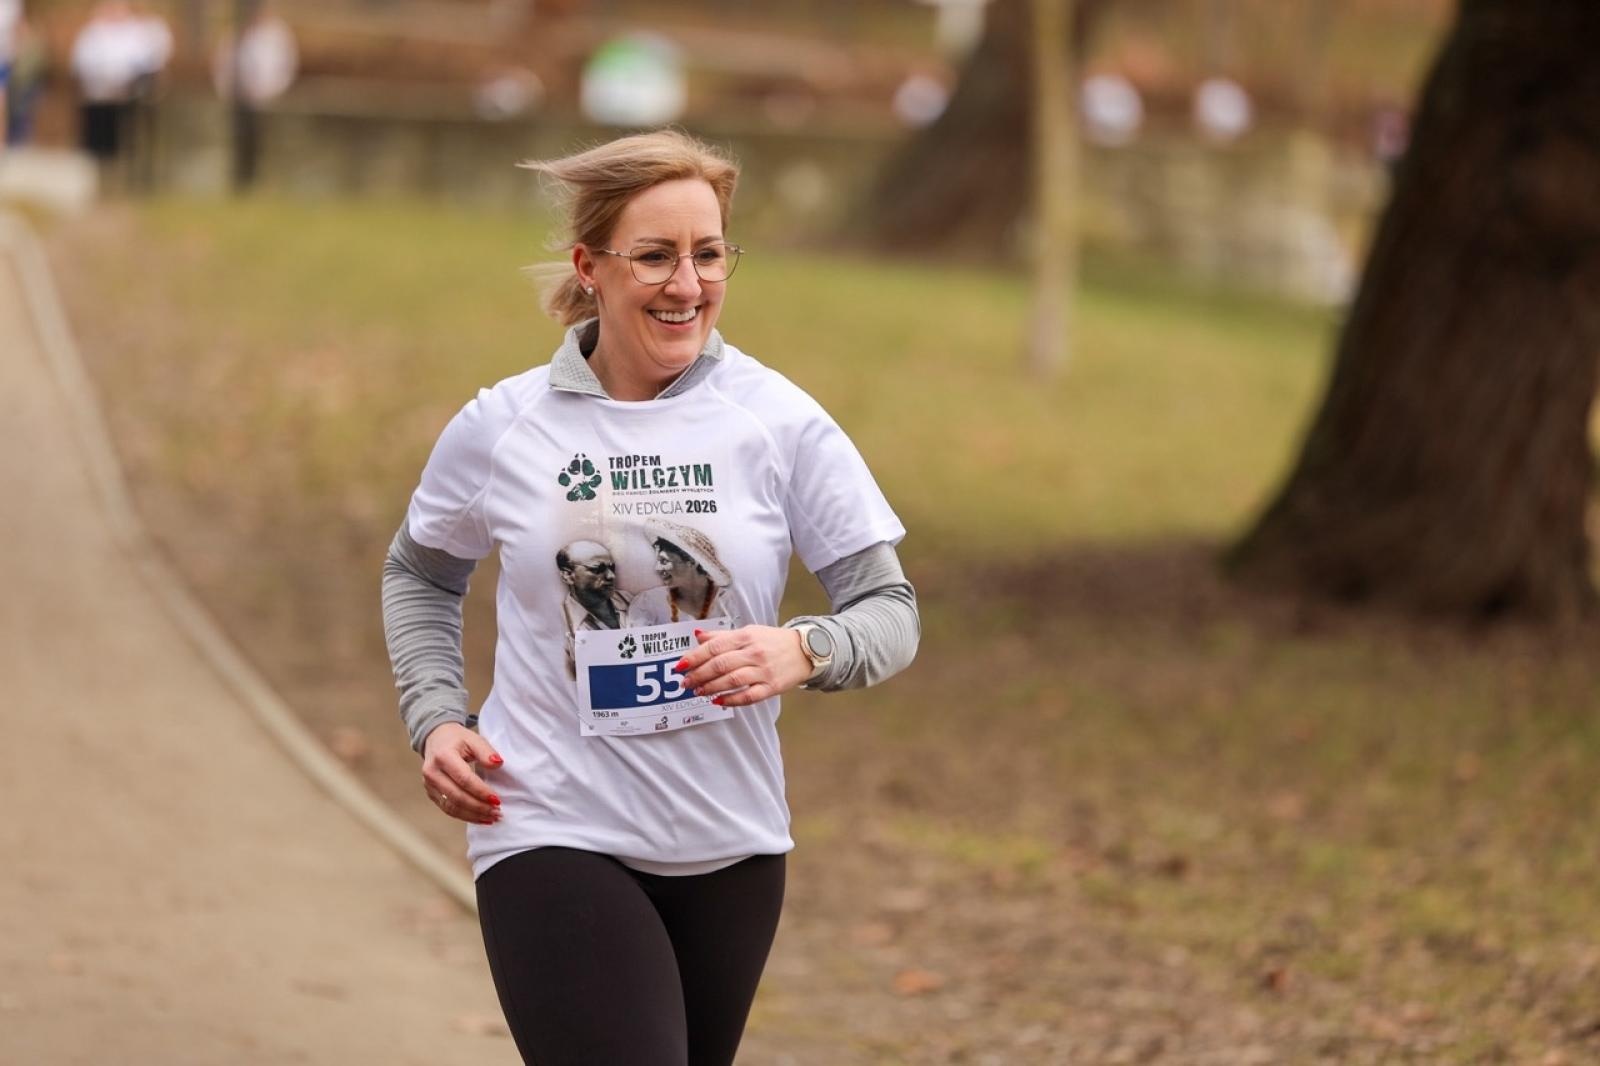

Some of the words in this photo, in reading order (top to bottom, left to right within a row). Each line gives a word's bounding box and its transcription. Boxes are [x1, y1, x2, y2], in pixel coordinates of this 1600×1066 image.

[608, 455, 661, 469] TROPEM
[610, 464, 713, 490] WILCZYM
[612, 502, 634, 515] XIV
[636, 500, 683, 515] EDYCJA
[685, 499, 717, 514] 2026
[641, 631, 667, 642] TROPEM
[642, 635, 690, 655] WILCZYM
[636, 660, 686, 703] 55
